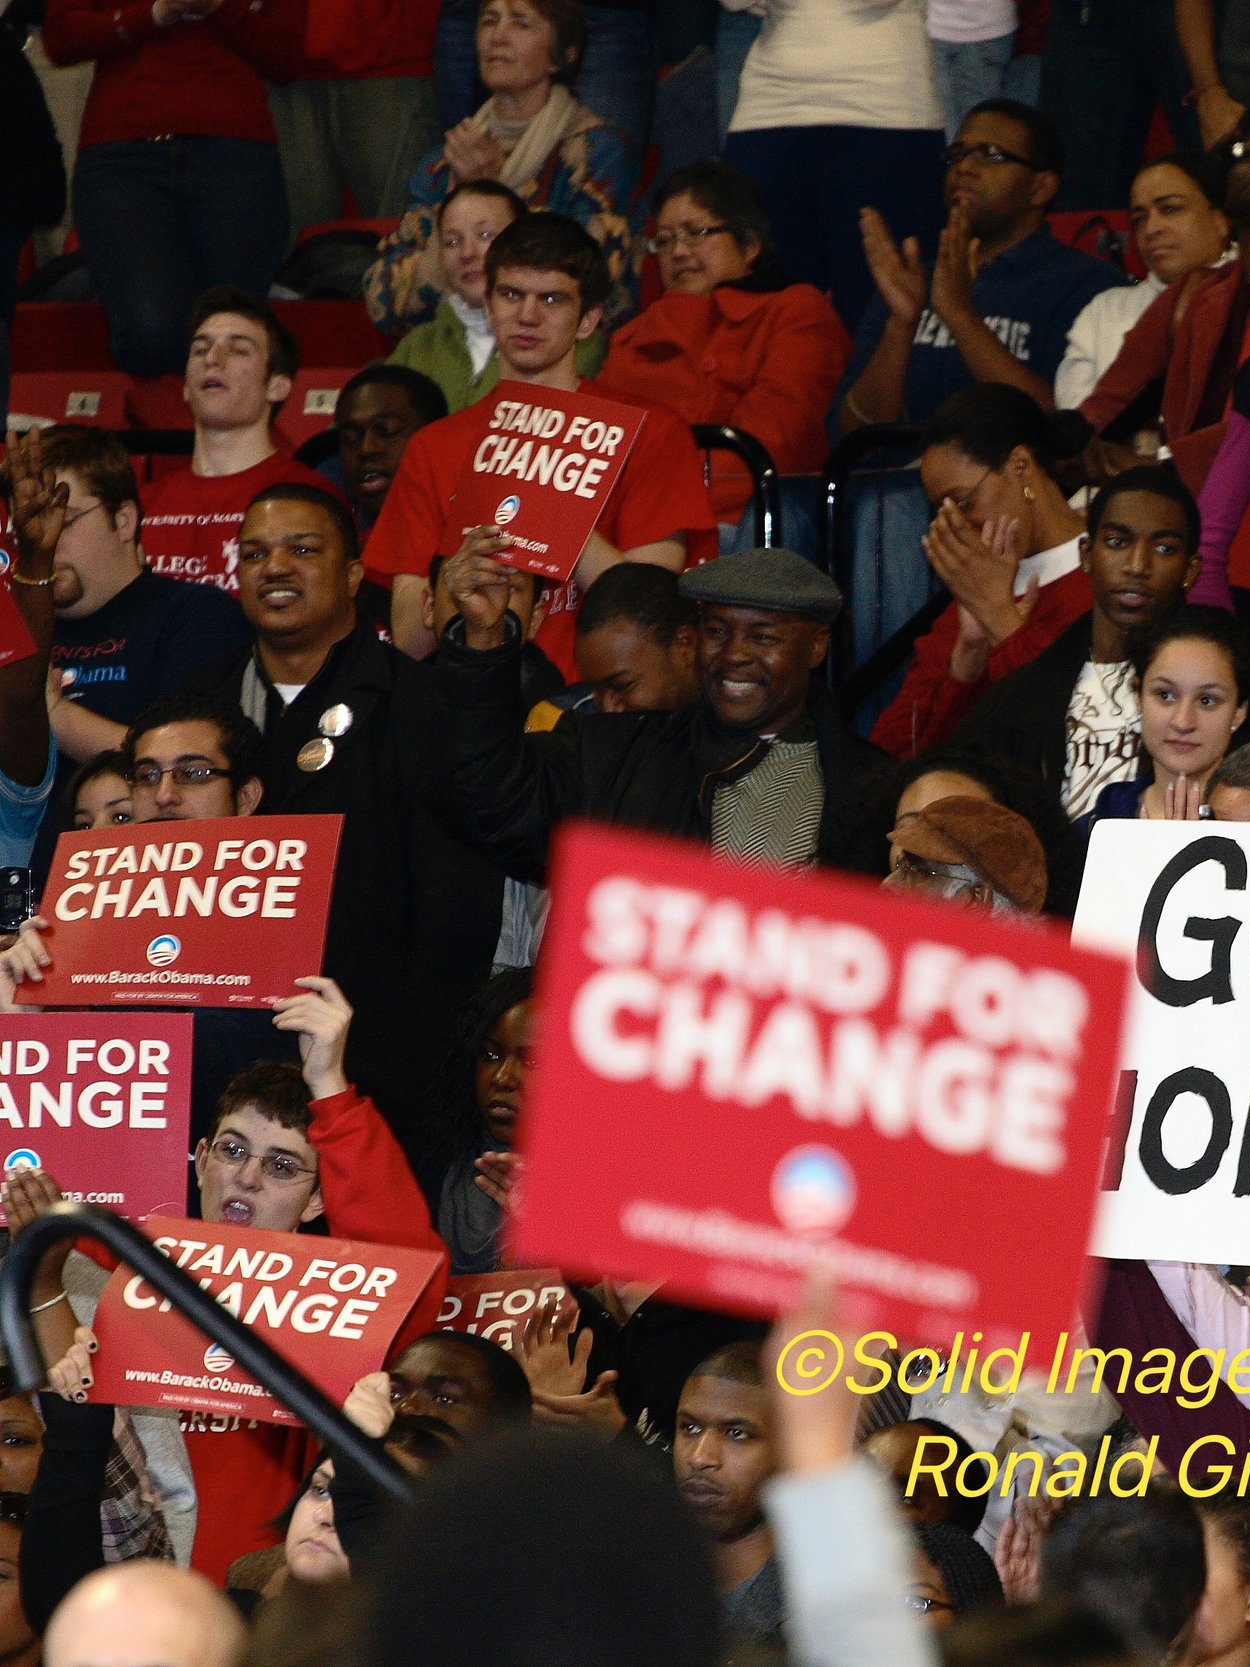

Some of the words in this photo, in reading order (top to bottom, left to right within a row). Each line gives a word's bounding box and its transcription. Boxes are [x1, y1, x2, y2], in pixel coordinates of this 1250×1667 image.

[489, 400, 566, 439] STAND
[562, 416, 625, 456] FOR
[473, 434, 610, 499] CHANGE
[64, 841, 204, 880] STAND
[214, 839, 308, 871] FOR
[55, 876, 301, 922] CHANGE
[71, 970, 251, 986] www.BarackObama.com
[584, 873, 894, 1016] STAND
[899, 939, 1092, 1059] FOR
[66, 1039, 170, 1075] FOR
[569, 965, 1079, 1178] CHANGE
[0, 1081, 168, 1129] ANGE
[153, 1237, 294, 1282] STAND
[299, 1259, 398, 1298] FOR
